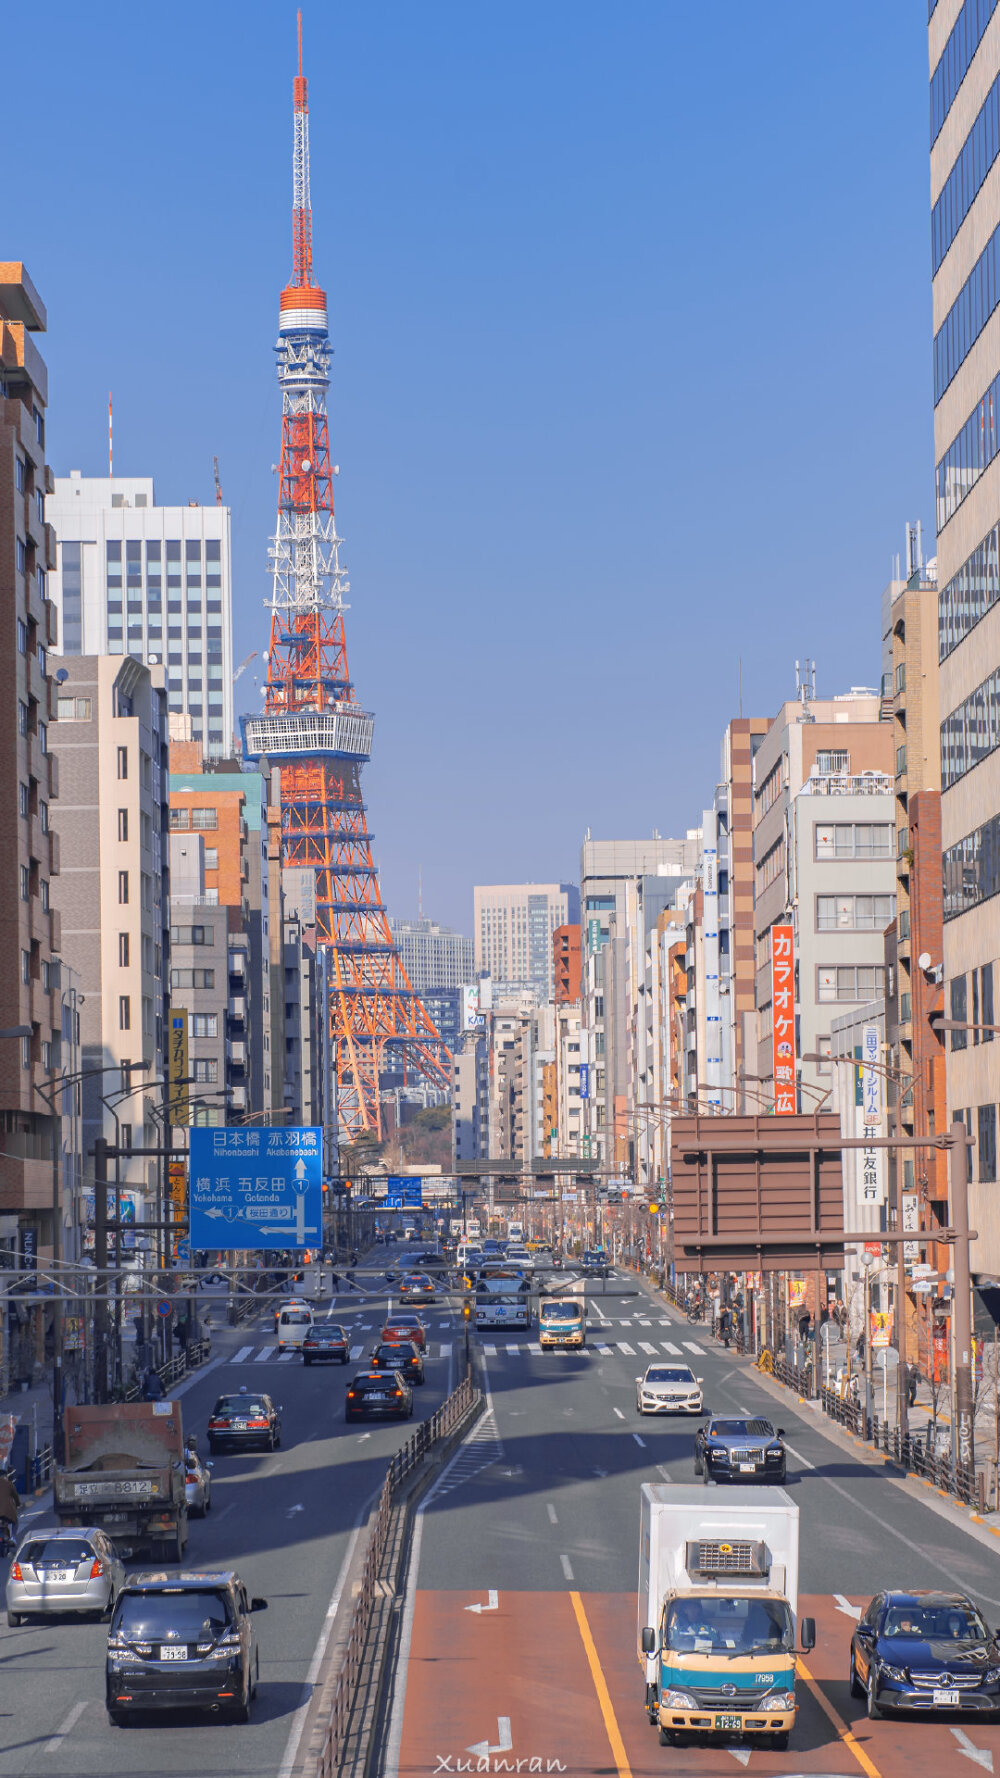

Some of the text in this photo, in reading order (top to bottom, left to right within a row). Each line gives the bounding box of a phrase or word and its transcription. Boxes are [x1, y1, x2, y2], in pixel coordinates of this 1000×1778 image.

[774, 934, 793, 1037] カラオケ
[213, 1131, 317, 1146] 日本橋 赤羽橋
[213, 1148, 319, 1156] Nihonbashi Akabanebashi
[196, 1177, 286, 1192] 横浜 五反田
[298, 1181, 303, 1190] 1
[193, 1193, 280, 1202] Yokohama Gotanda
[228, 1208, 232, 1217] 1
[249, 1208, 288, 1217] 桜田通り
